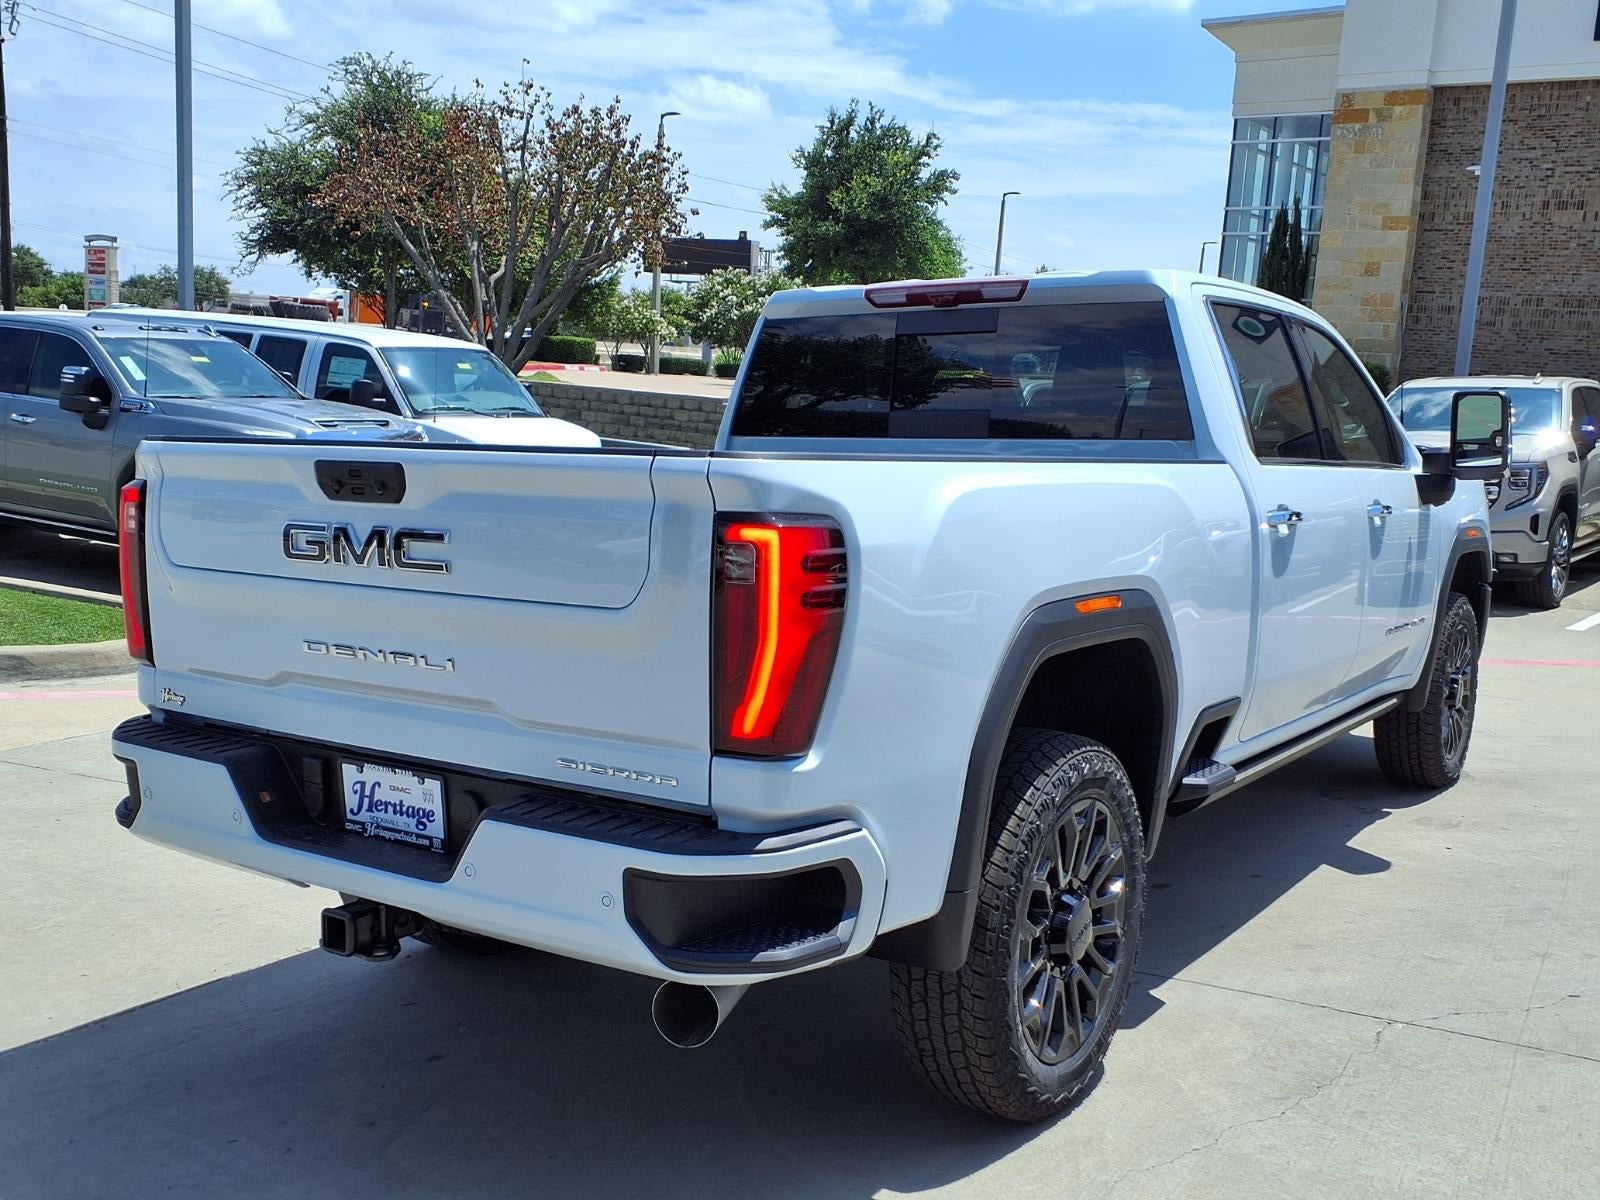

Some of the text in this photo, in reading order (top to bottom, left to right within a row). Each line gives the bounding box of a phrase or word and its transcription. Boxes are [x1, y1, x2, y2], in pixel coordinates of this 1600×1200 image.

[282, 521, 451, 575] GMC
[302, 638, 456, 672] DENALI
[556, 757, 679, 788] SIERRA
[349, 780, 435, 831] Heritage
[389, 784, 412, 795] GMC
[345, 822, 363, 833] GMC
